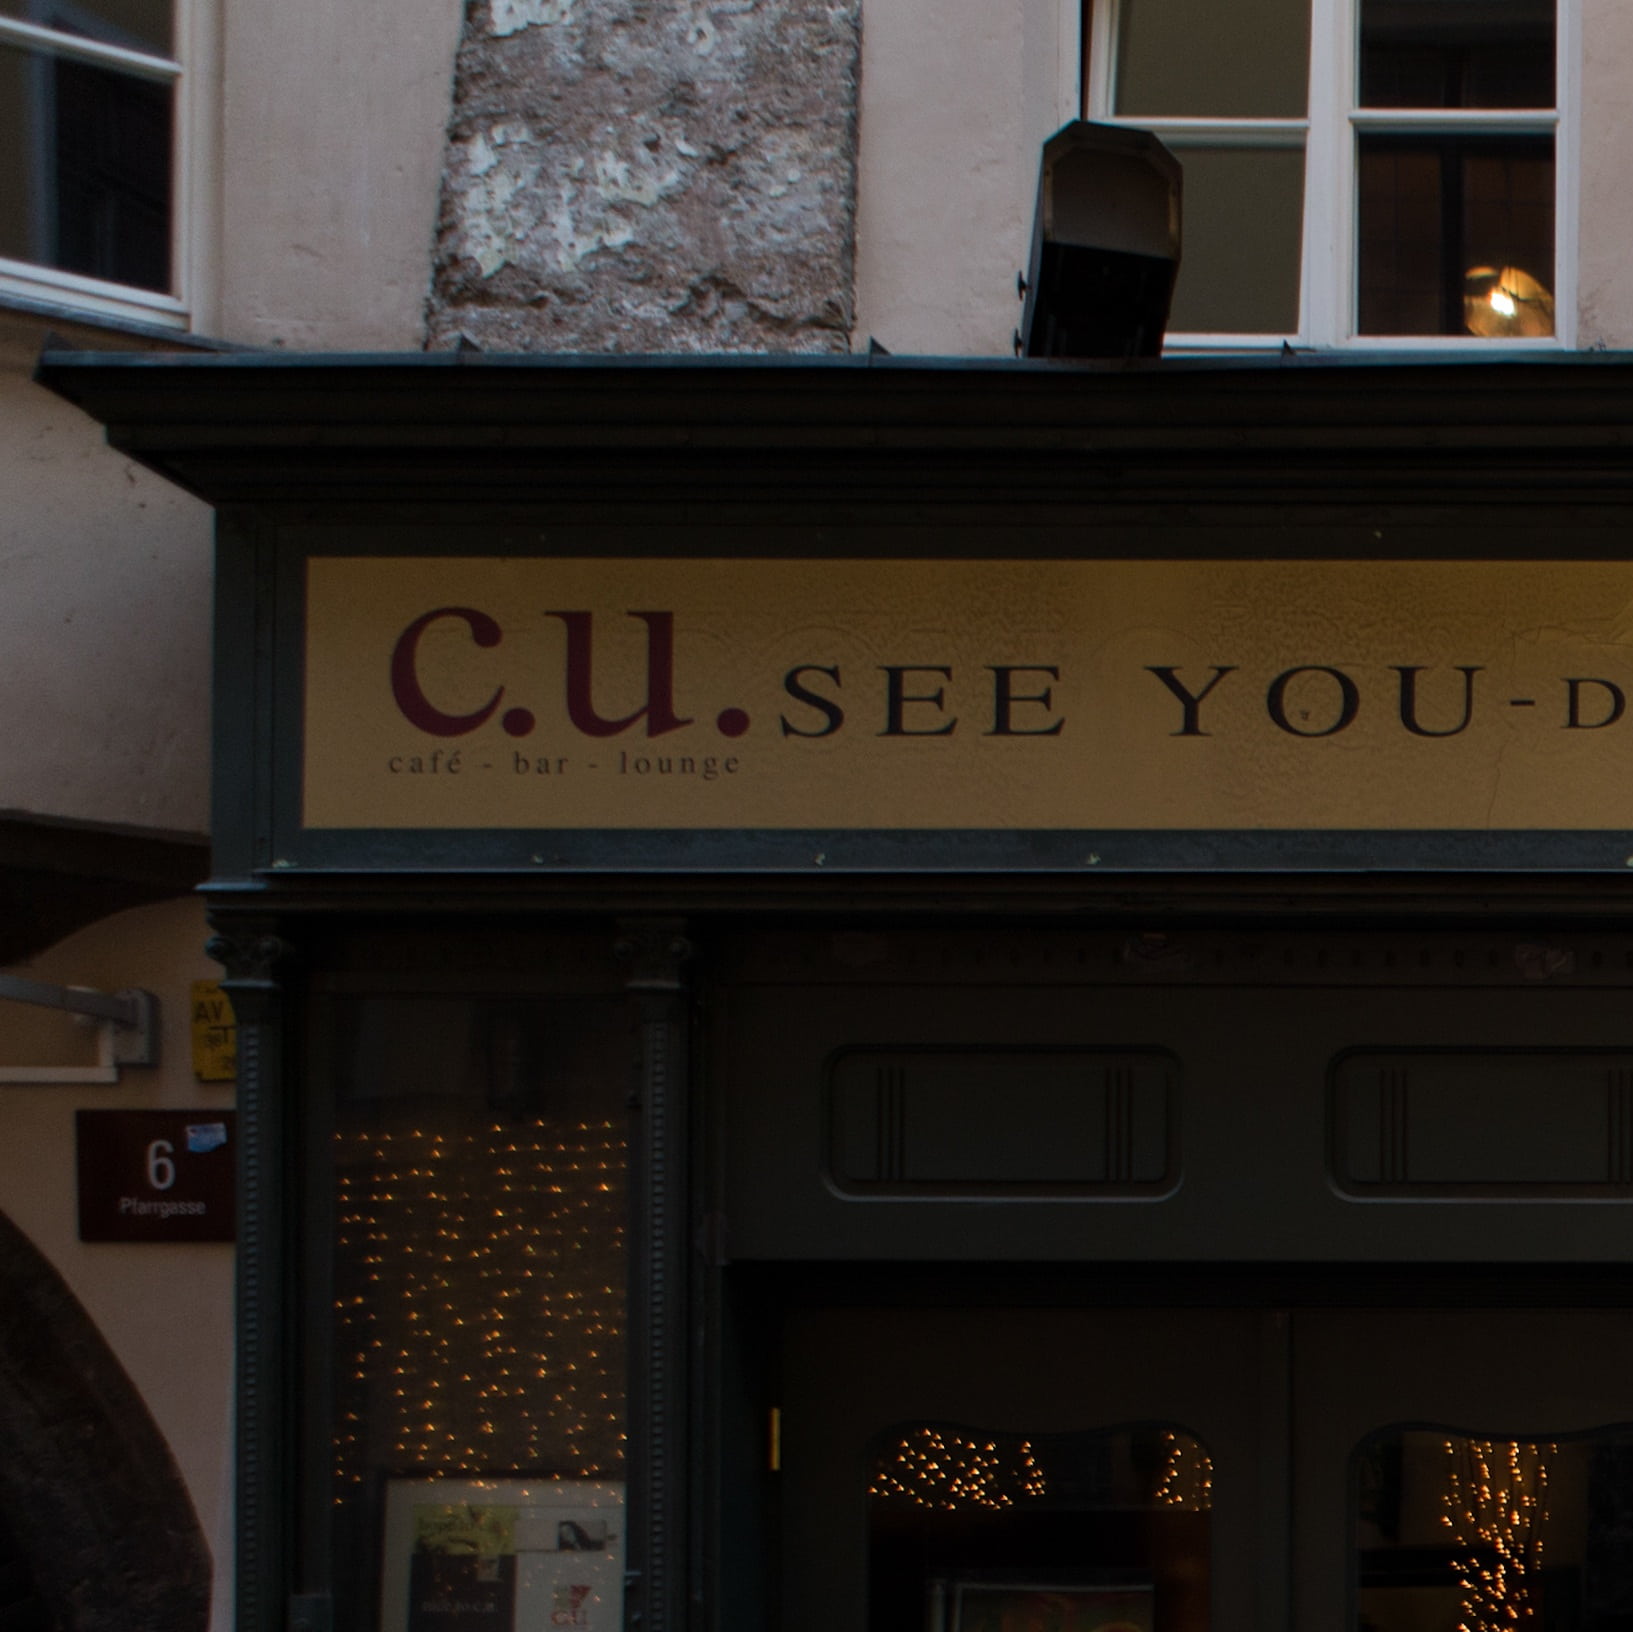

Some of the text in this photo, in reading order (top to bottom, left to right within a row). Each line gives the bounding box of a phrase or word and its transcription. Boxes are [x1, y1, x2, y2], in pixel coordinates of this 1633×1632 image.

[780, 664, 1067, 738] SEE
[388, 749, 463, 775] café
[513, 751, 570, 775] bar
[619, 750, 742, 781] lounge
[147, 1139, 176, 1191] 6
